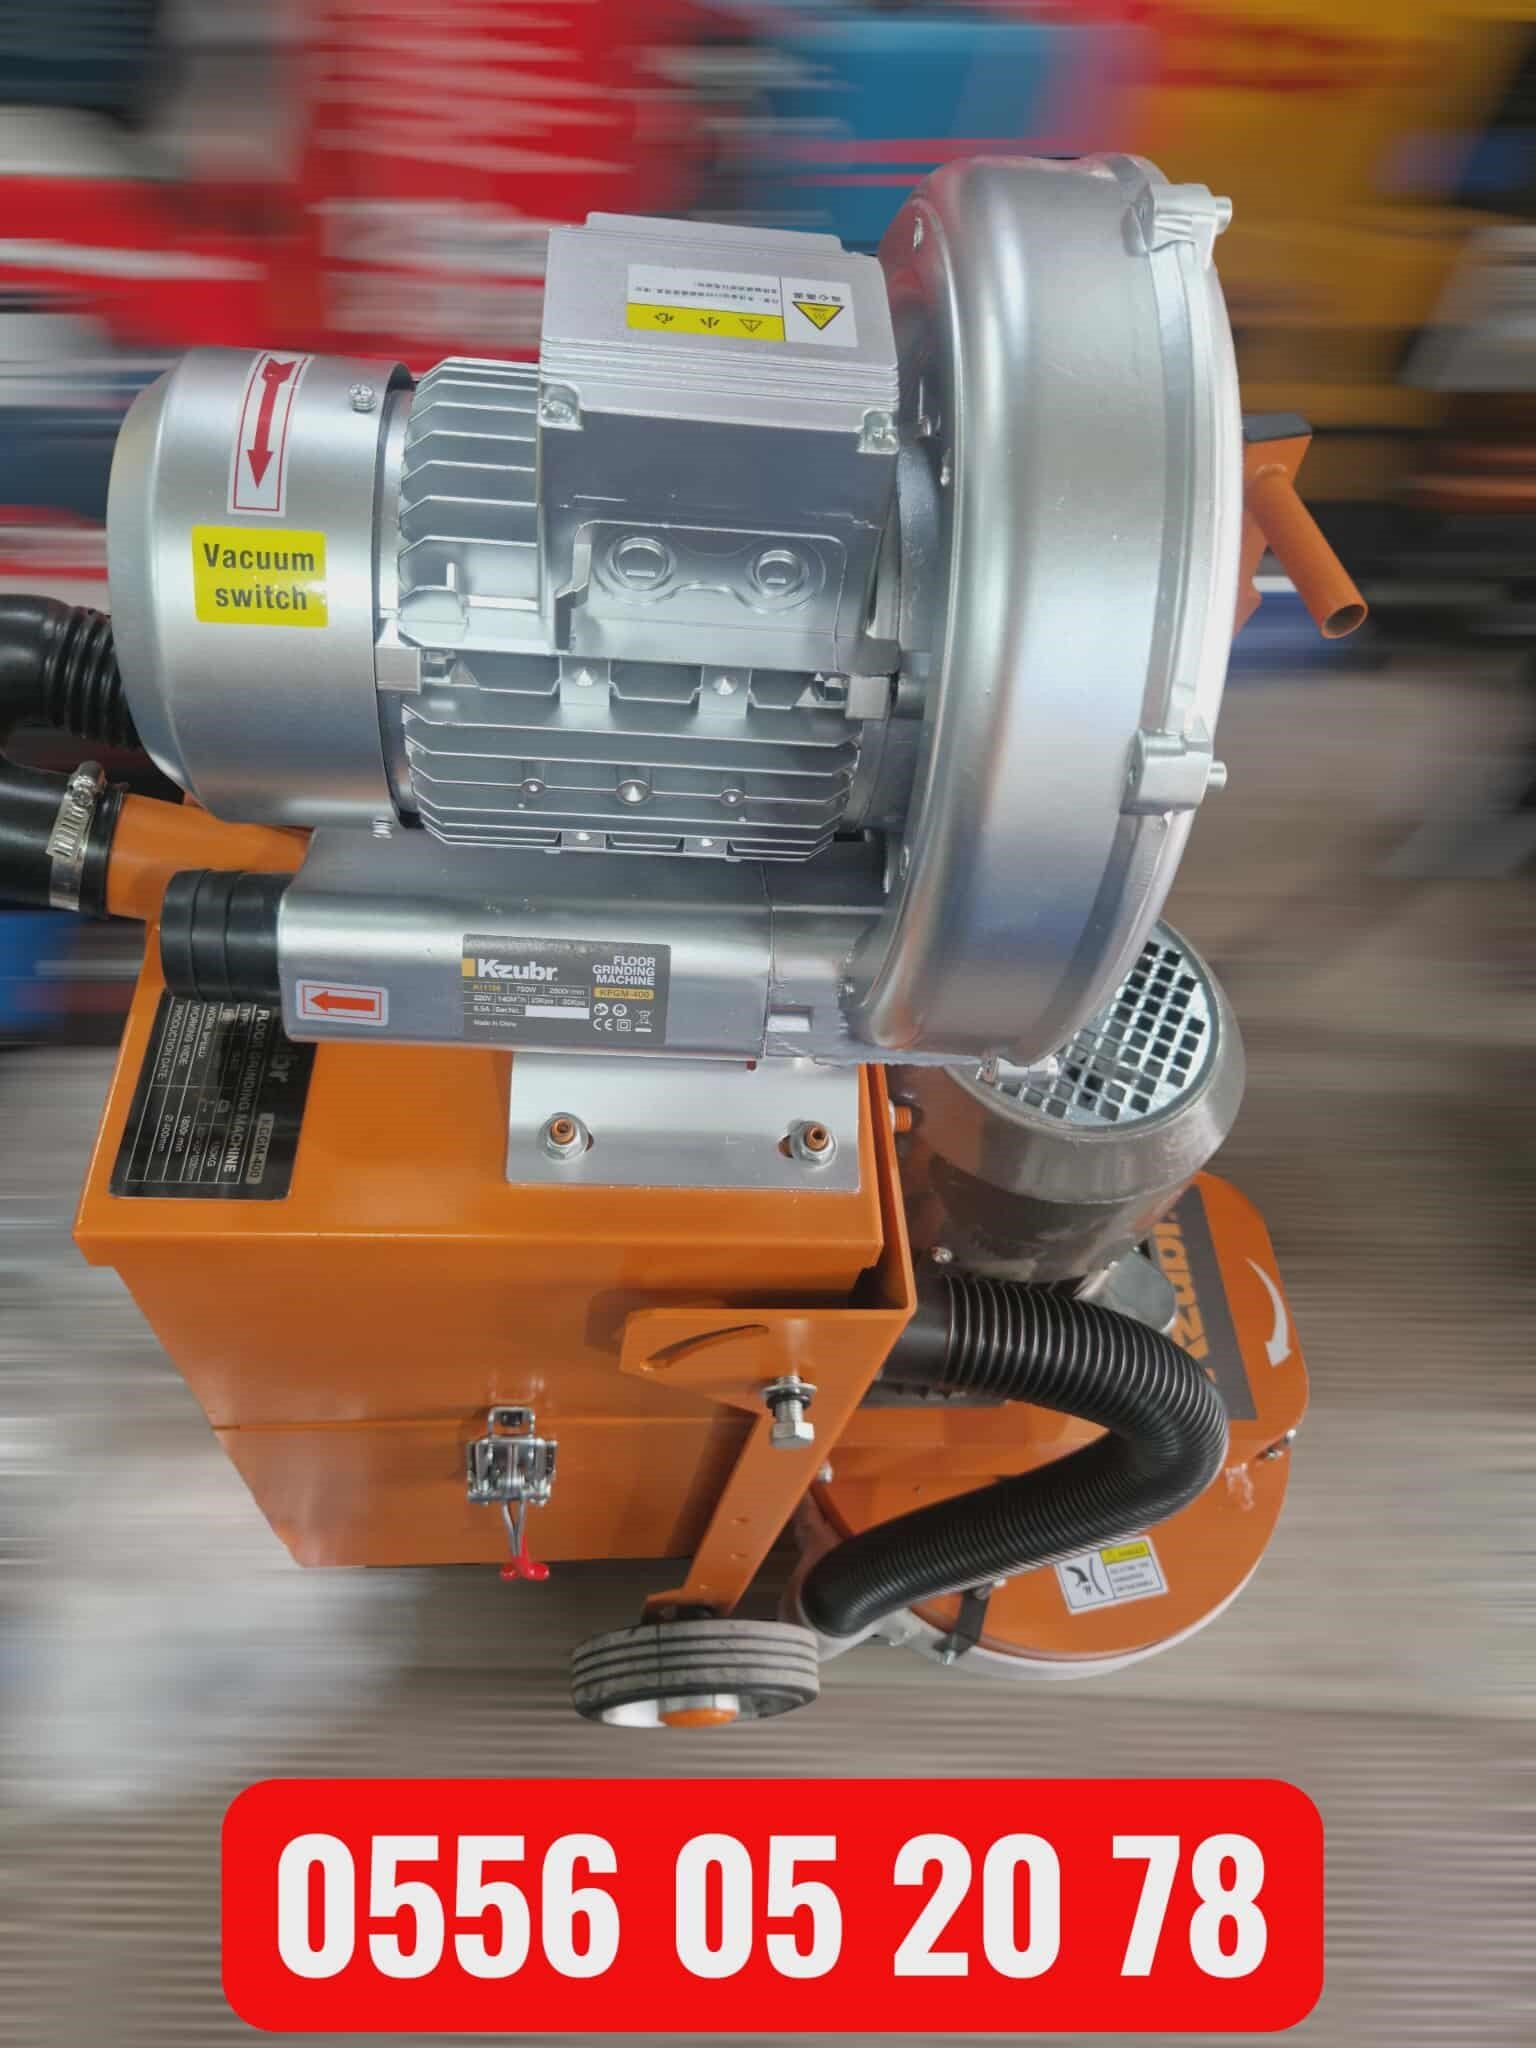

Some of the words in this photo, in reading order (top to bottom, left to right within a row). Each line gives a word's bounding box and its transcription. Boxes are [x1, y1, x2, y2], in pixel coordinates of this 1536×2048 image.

[203, 543, 315, 571] Vacuum
[215, 584, 308, 610] switch
[478, 958, 558, 981] Kzubr
[592, 964, 656, 977] GRINDING
[613, 955, 656, 967] FLOOR
[596, 974, 655, 986] MACHINE
[223, 1112, 249, 1173] MACHINE
